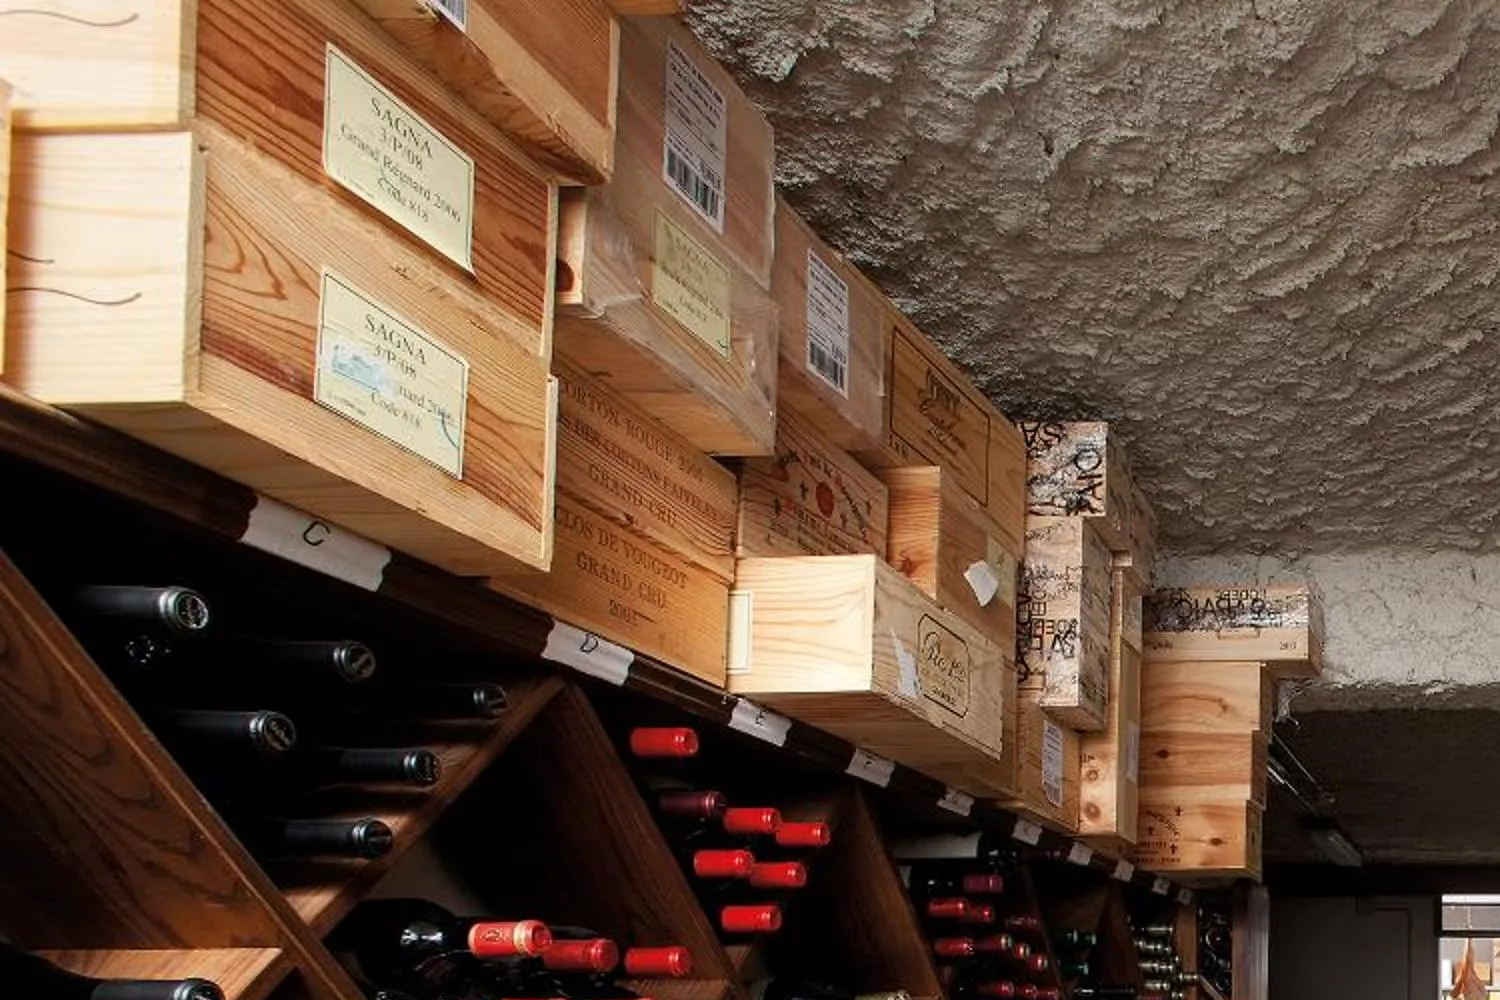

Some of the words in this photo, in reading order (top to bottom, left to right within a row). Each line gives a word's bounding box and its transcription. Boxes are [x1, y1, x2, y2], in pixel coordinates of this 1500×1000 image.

[370, 97, 433, 159] SAGNA
[364, 312, 427, 366] SAGNA
[597, 526, 619, 553] DE
[576, 550, 633, 592] GRAND
[638, 580, 669, 609] CRU
